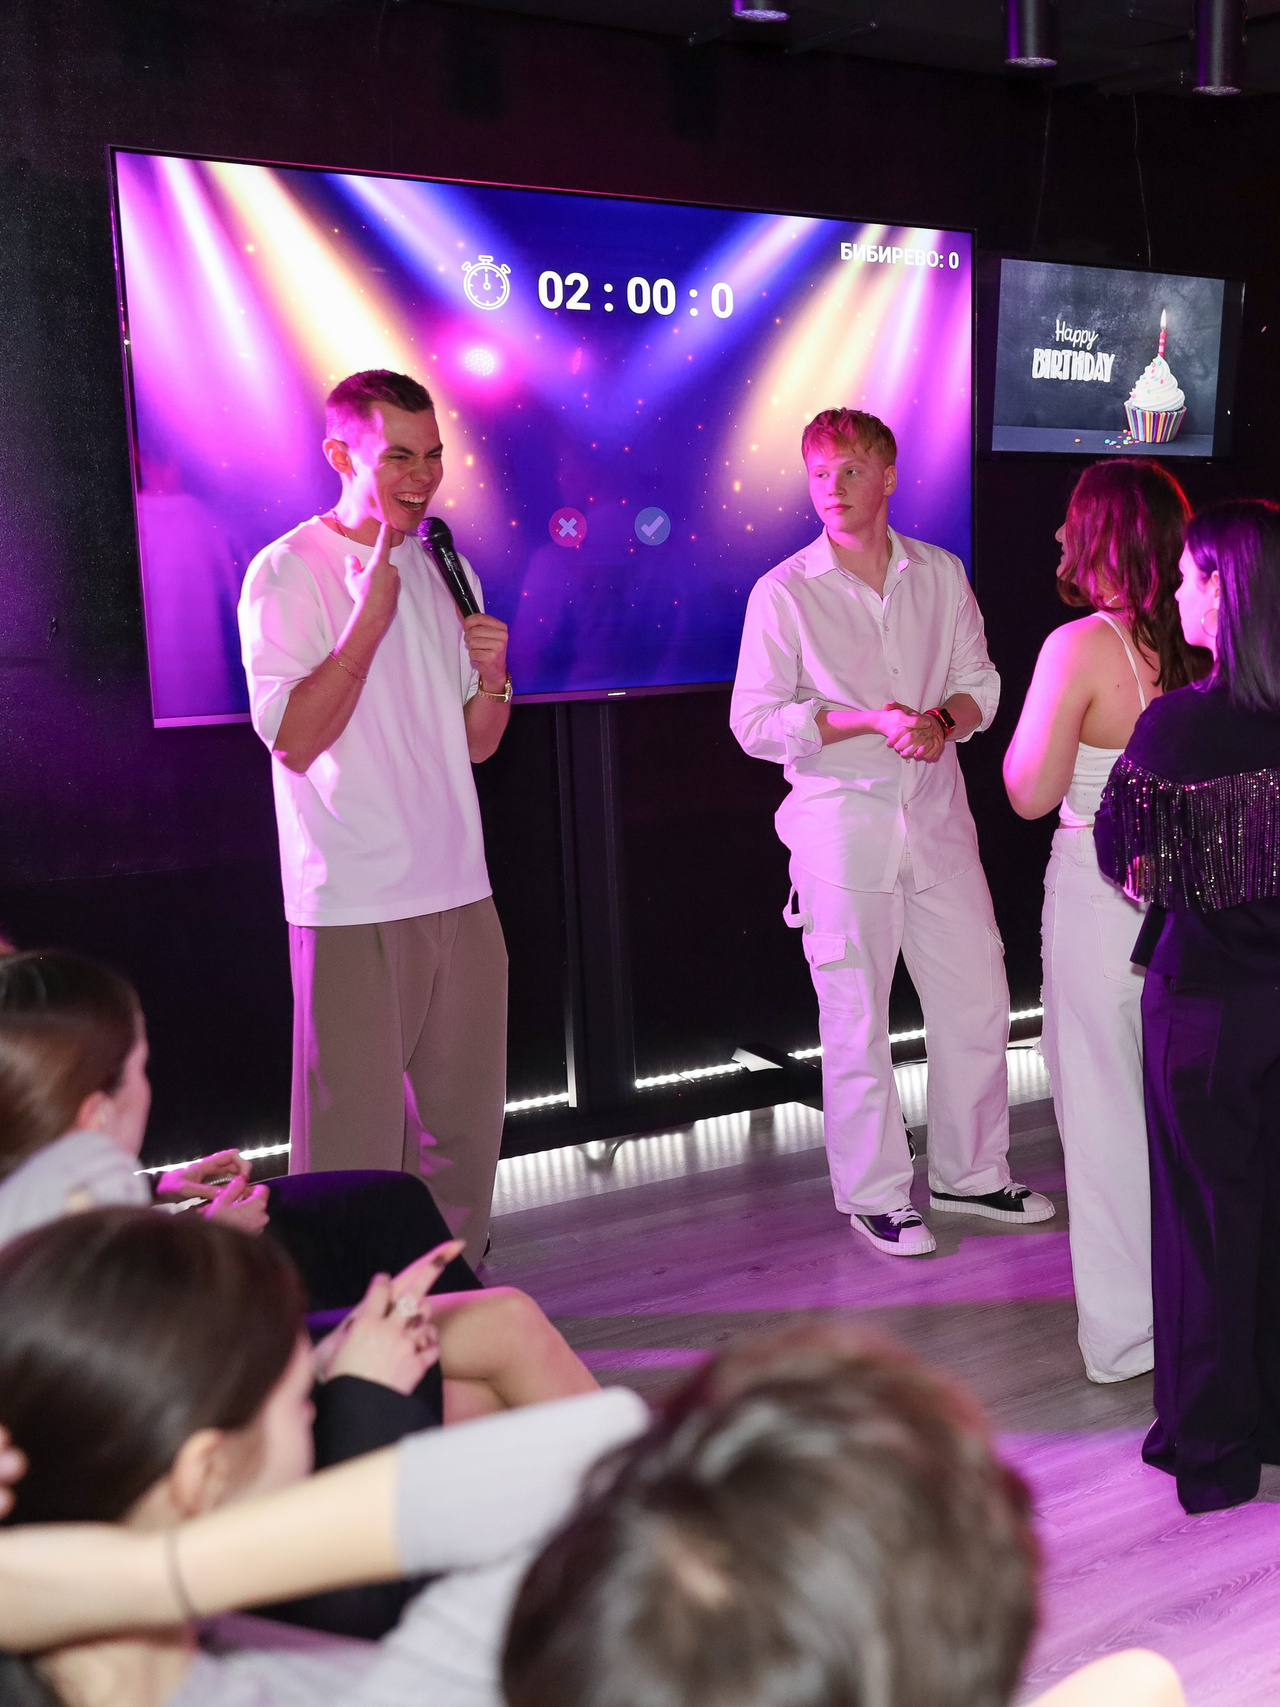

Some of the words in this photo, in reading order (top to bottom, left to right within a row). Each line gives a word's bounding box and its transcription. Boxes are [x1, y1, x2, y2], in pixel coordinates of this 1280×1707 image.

[840, 242, 944, 268] БИБИРЕВО:
[948, 251, 960, 270] 0
[538, 270, 591, 311] 02
[627, 276, 677, 316] 00
[711, 282, 734, 319] 0
[1055, 319, 1099, 350] Happy
[1032, 348, 1116, 383] BIRTHDAY
